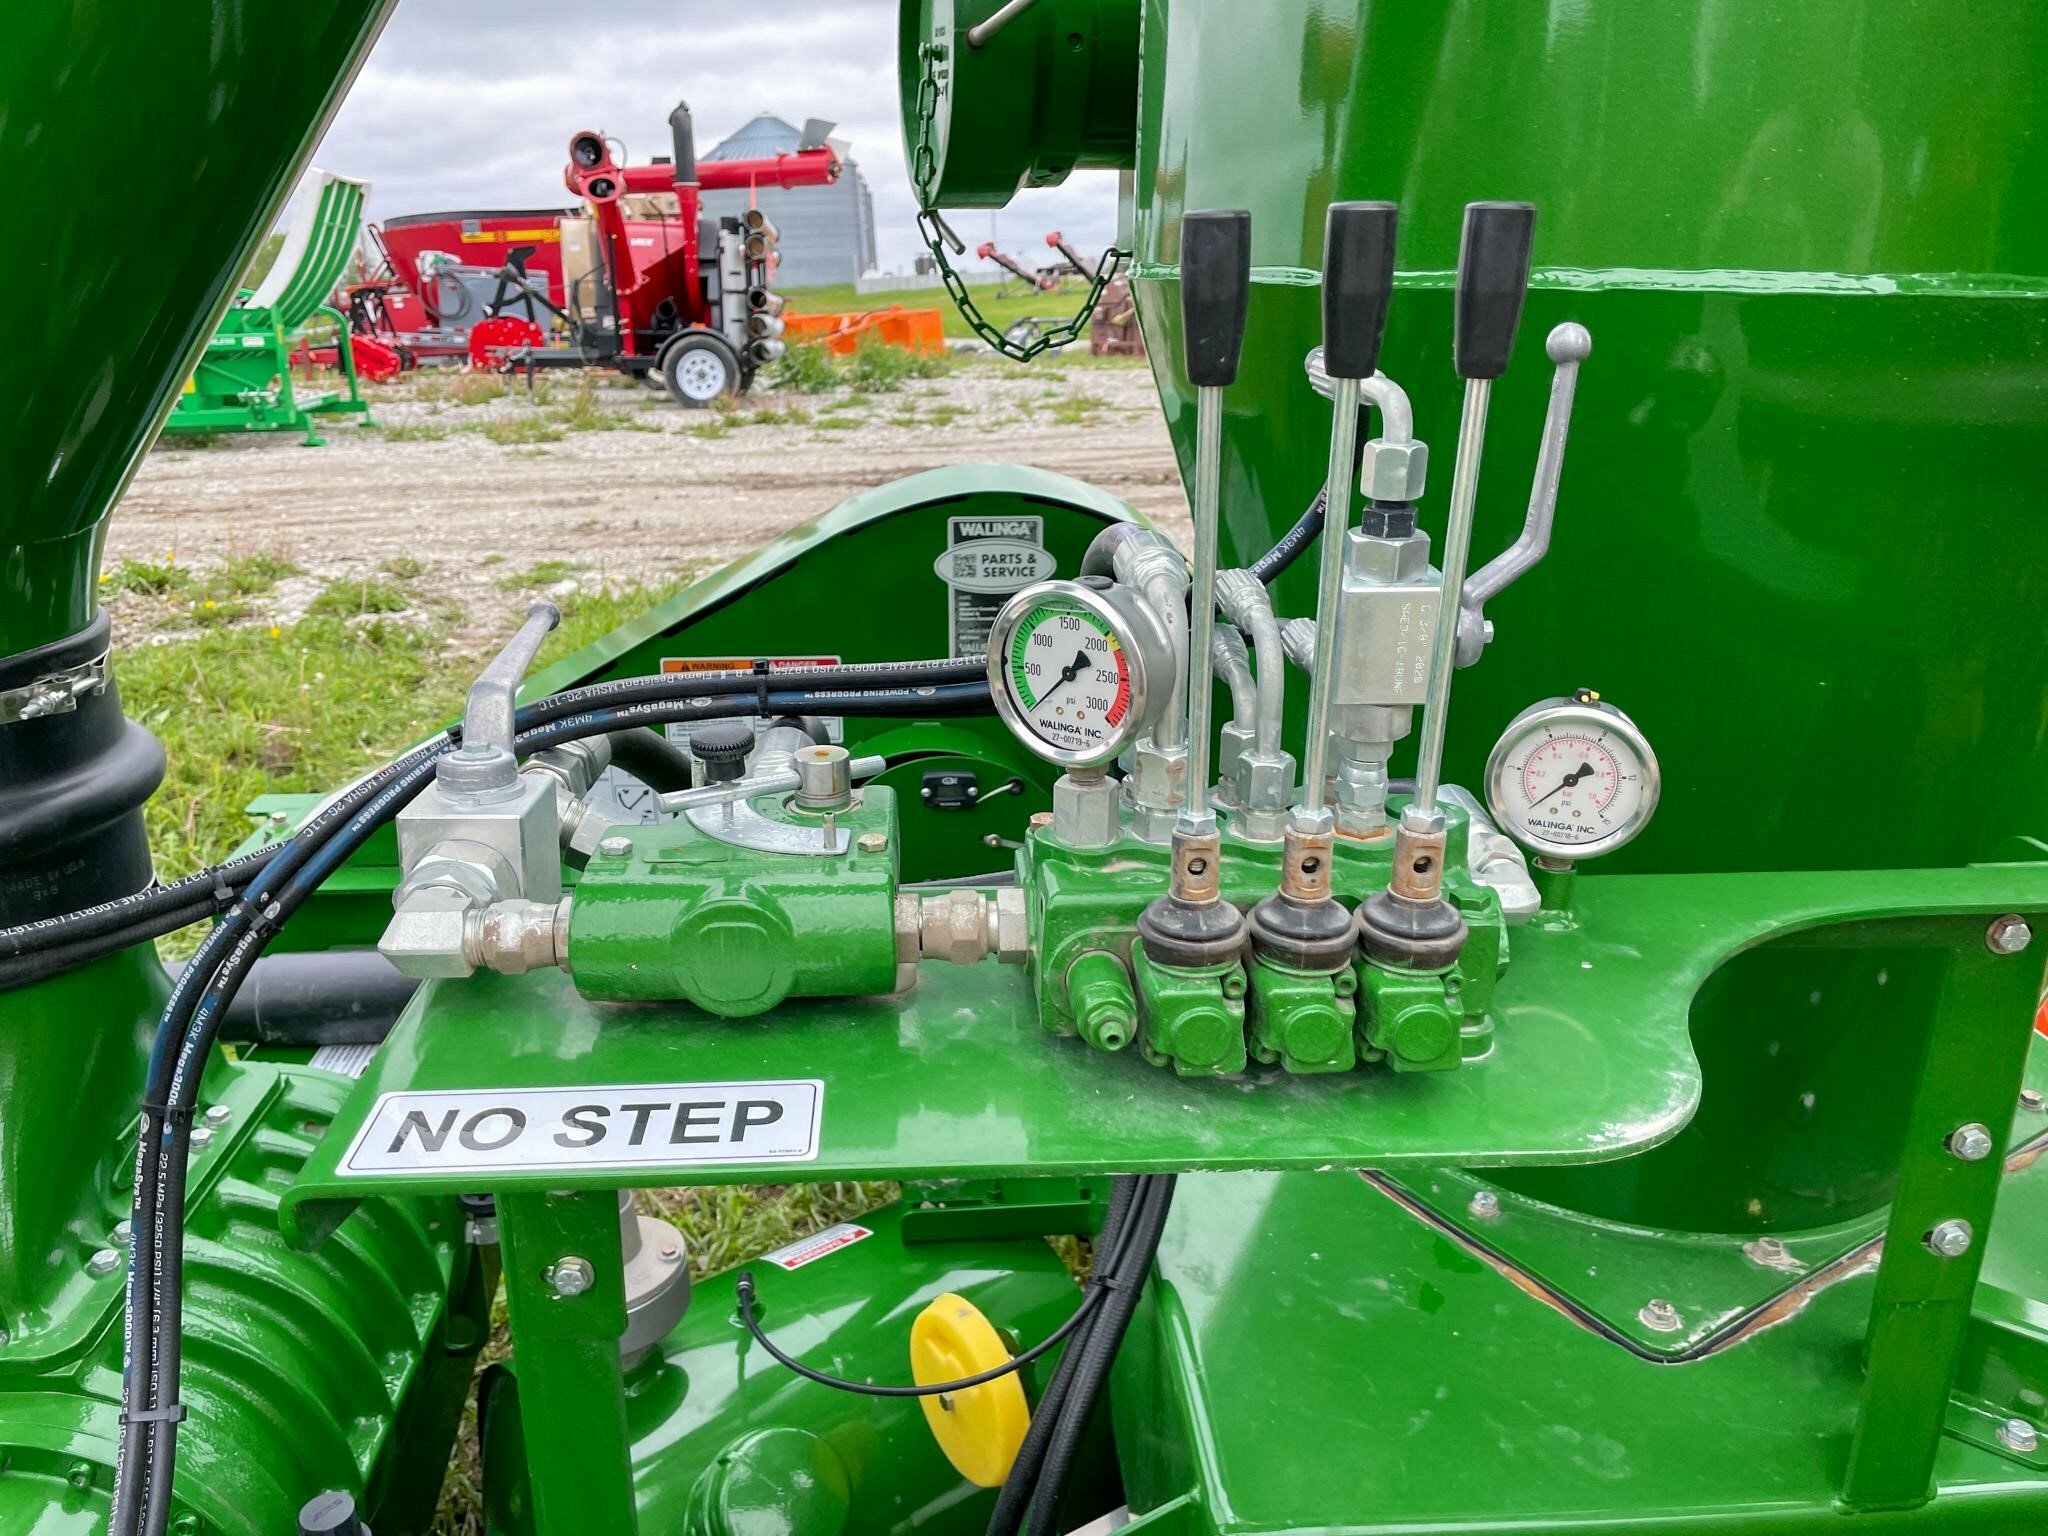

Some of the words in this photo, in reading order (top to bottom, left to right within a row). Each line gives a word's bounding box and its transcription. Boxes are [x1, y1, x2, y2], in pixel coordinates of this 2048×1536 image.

[959, 522, 1030, 537] WALINGA
[1279, 526, 1306, 553] 4M3K
[981, 553, 1022, 565] PARTS
[1027, 553, 1037, 564] &
[983, 566, 1036, 577] SERVICE
[1058, 616, 1080, 631] 1500
[1032, 633, 1053, 648] 1000
[1084, 637, 1108, 652] 2000
[691, 662, 735, 670] WARNING
[812, 665, 832, 674] ISO
[841, 663, 883, 673] 100R17
[886, 663, 906, 671] SAE
[917, 660, 939, 669] R17
[942, 657, 977, 668] 11237
[1025, 662, 1041, 676] 500
[677, 671, 711, 680] Flame
[774, 666, 808, 675] 18752
[1096, 669, 1119, 684] 2500
[622, 675, 674, 688] Resistant
[585, 683, 618, 697] MSHA
[863, 688, 909, 697] POWERING
[539, 691, 582, 711] 2G-11C
[1066, 697, 1076, 705] psi
[1086, 696, 1109, 711] 3000
[560, 714, 593, 729] 4M3K
[1039, 718, 1083, 735] WALINGA
[1084, 727, 1104, 740] INC.
[513, 723, 556, 745] Mega3
[376, 749, 429, 781] Resistant
[400, 752, 442, 787] POWERING
[343, 779, 378, 804] MSHA
[303, 801, 345, 838] 2G-11C
[1527, 818, 1573, 831] WALINGA
[1576, 825, 1597, 835] INC.
[226, 855, 247, 869] ISO
[121, 892, 146, 906] SAE
[70, 902, 120, 921] 100R17
[34, 917, 59, 929] ISO
[192, 920, 228, 966] POWERING
[188, 1007, 209, 1040] 4M3K
[387, 1107, 528, 1153] NO
[553, 1099, 784, 1148] STEP
[155, 1182, 166, 1208] MPa
